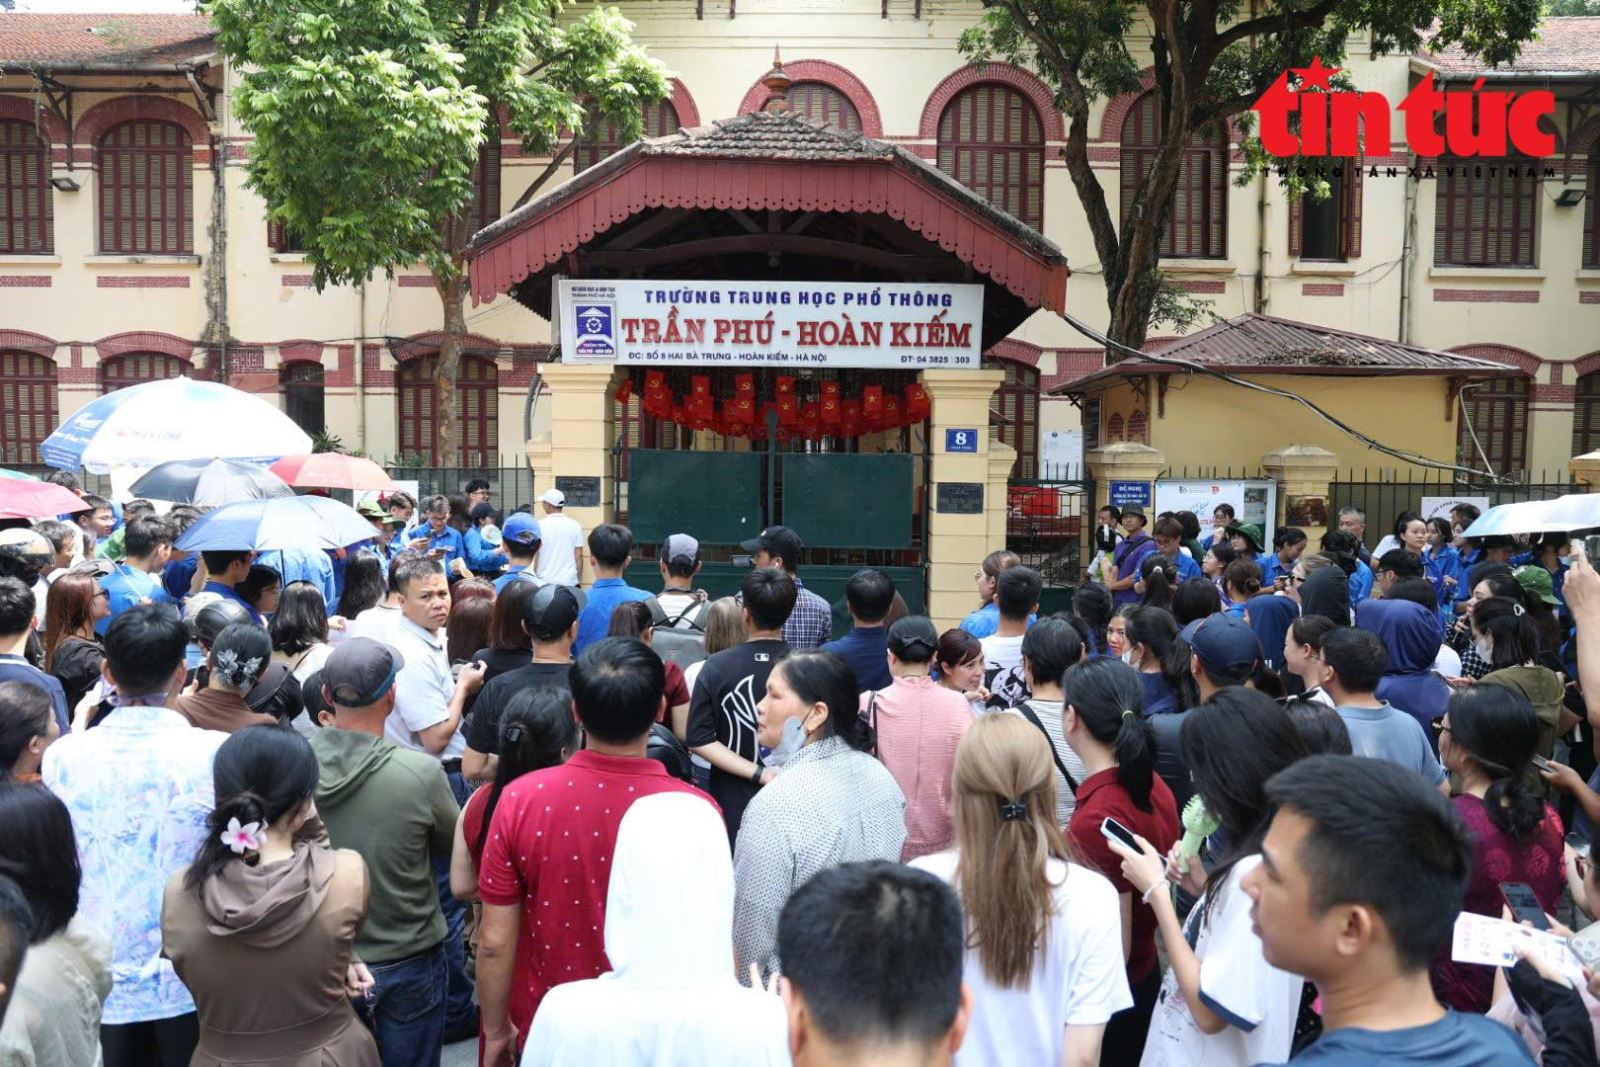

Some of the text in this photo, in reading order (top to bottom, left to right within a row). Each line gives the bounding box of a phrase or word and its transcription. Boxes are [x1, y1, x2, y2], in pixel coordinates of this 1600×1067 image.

[644, 286, 953, 308] TRƯỜNG TRUNG HỌC PHỔ THÔNG
[621, 305, 706, 343] TRẦN
[713, 310, 775, 345] PHÚ
[796, 312, 883, 347] HOÀN
[889, 308, 973, 348] KIẾM
[628, 352, 644, 360] ĐC:
[646, 350, 659, 360] SỐ
[686, 351, 699, 360] BÀ
[702, 352, 732, 361] TRƯNG
[739, 351, 765, 361] HOÀN
[767, 350, 789, 361] KIẾM
[795, 351, 809, 362] HÀ
[811, 352, 827, 363] NỘI
[917, 356, 927, 364] 04
[929, 356, 949, 364] 3825
[955, 432, 967, 445] 8
